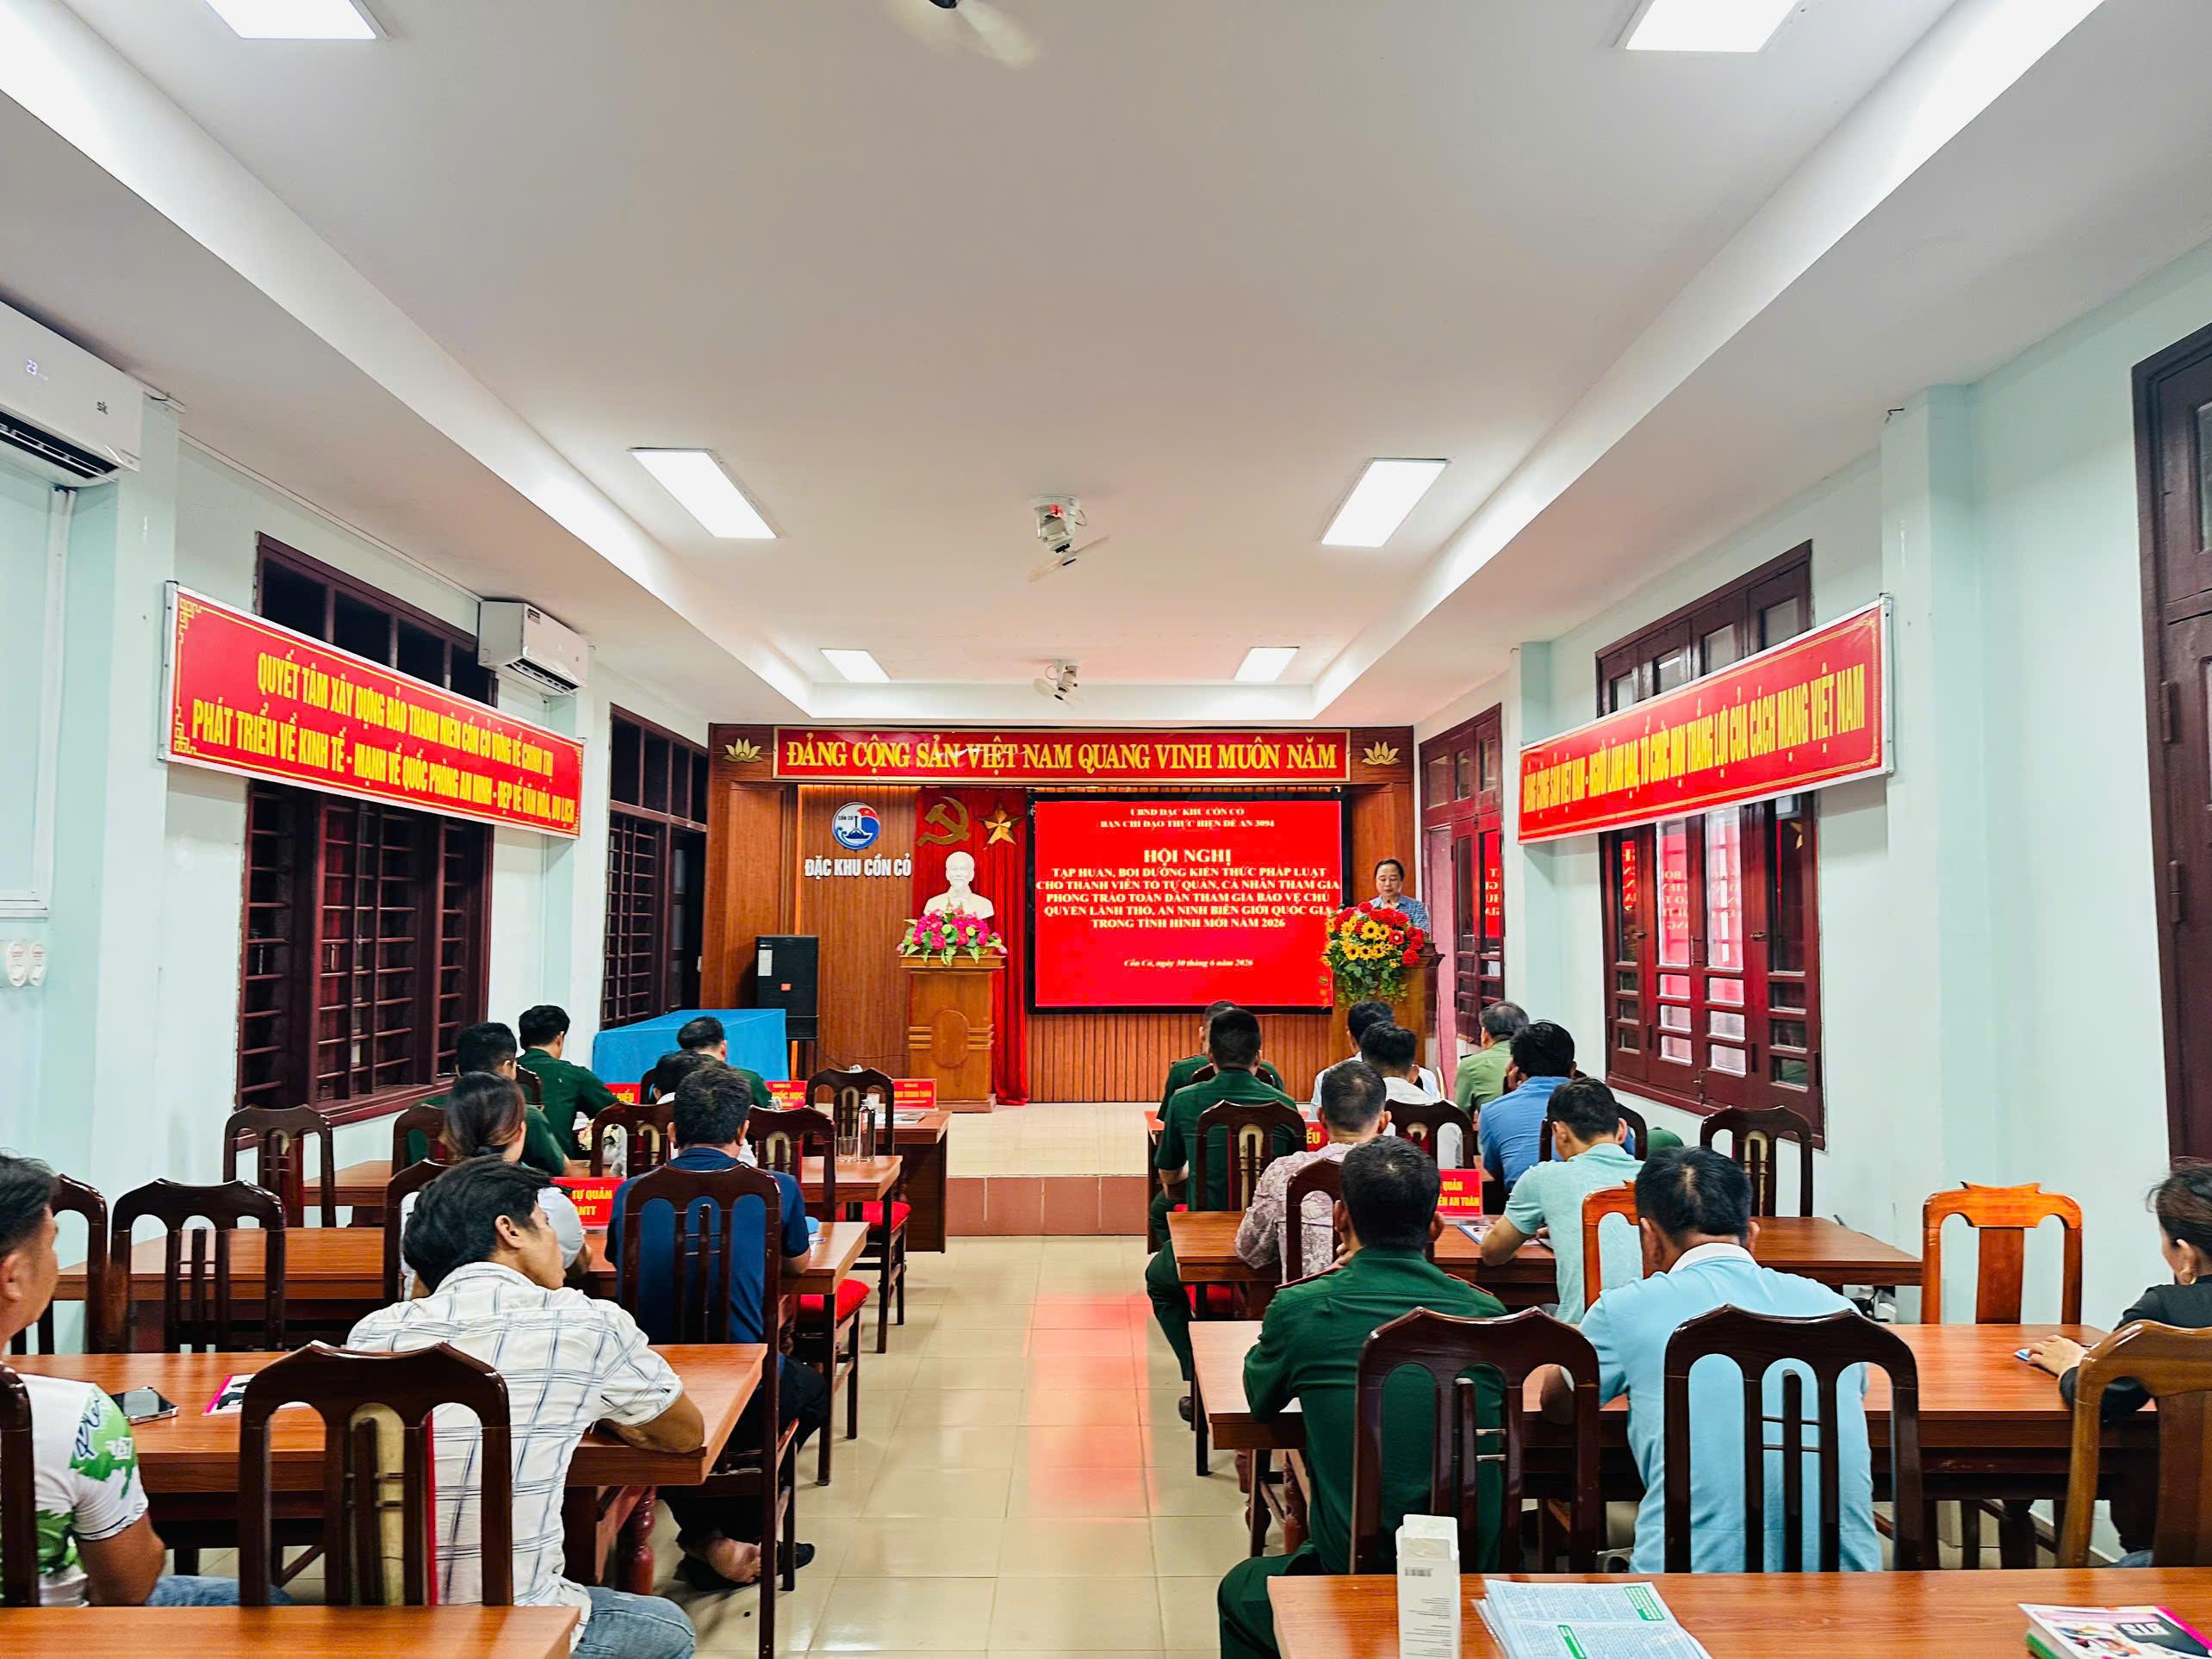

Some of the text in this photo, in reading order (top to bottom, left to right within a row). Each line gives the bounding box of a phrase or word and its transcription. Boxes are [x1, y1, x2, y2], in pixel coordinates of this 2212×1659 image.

[258, 649, 300, 699] QUYẾT
[301, 662, 329, 709] TÂM
[331, 674, 353, 717] XÂY
[355, 685, 385, 730] DỰNG
[387, 686, 407, 733] ĐẢO
[408, 704, 439, 743] THANH
[440, 711, 462, 749] NIÊN
[480, 718, 491, 758] CỎ
[1640, 716, 1650, 785] TỔ
[1650, 720, 1670, 783] CHỨC
[1671, 724, 1686, 788] MỌI
[1687, 698, 1713, 773] THẮNG
[1714, 705, 1728, 778] LỢI
[1730, 686, 1749, 763] CỦA
[1749, 686, 1775, 758] CÁCH
[1777, 682, 1809, 762] MẠNG
[1811, 662, 1835, 753] VIỆT
[1836, 663, 1865, 735] NAM
[192, 697, 233, 746] PHÁT
[236, 702, 277, 757] TRIỂN
[280, 712, 297, 762] VỀ
[298, 728, 329, 769] KINH
[331, 726, 345, 773] TẾ
[354, 743, 387, 786] MẠNH
[388, 743, 401, 786] VỀ
[402, 749, 428, 791] QUỐC
[429, 758, 459, 798] PHÒNG
[459, 771, 472, 801] AN
[473, 774, 493, 805] NINH
[498, 780, 513, 815] ĐẸP
[786, 732, 1337, 775] ĐẢNG CỘNG SẢN VIỆT NAM QUANG VINH MUÔN NĂM
[805, 853, 911, 879] ĐẶC KHU CỒN CỎ
[1143, 848, 1232, 867] HỘI NGHỊ
[1035, 880, 1064, 890] CHO
[1110, 879, 1140, 890] VIÊN
[1277, 880, 1315, 890] THAM
[1317, 880, 1340, 890] GIA
[1047, 893, 1089, 903] PHONG
[1193, 893, 1229, 903] THAM
[1231, 893, 1254, 903] GIA
[1158, 906, 1174, 916] AN
[1177, 906, 1208, 916] NINH
[1091, 918, 1134, 929] TRONG
[1261, 918, 1285, 928] 2026
[586, 1186, 612, 1202] QUẢN
